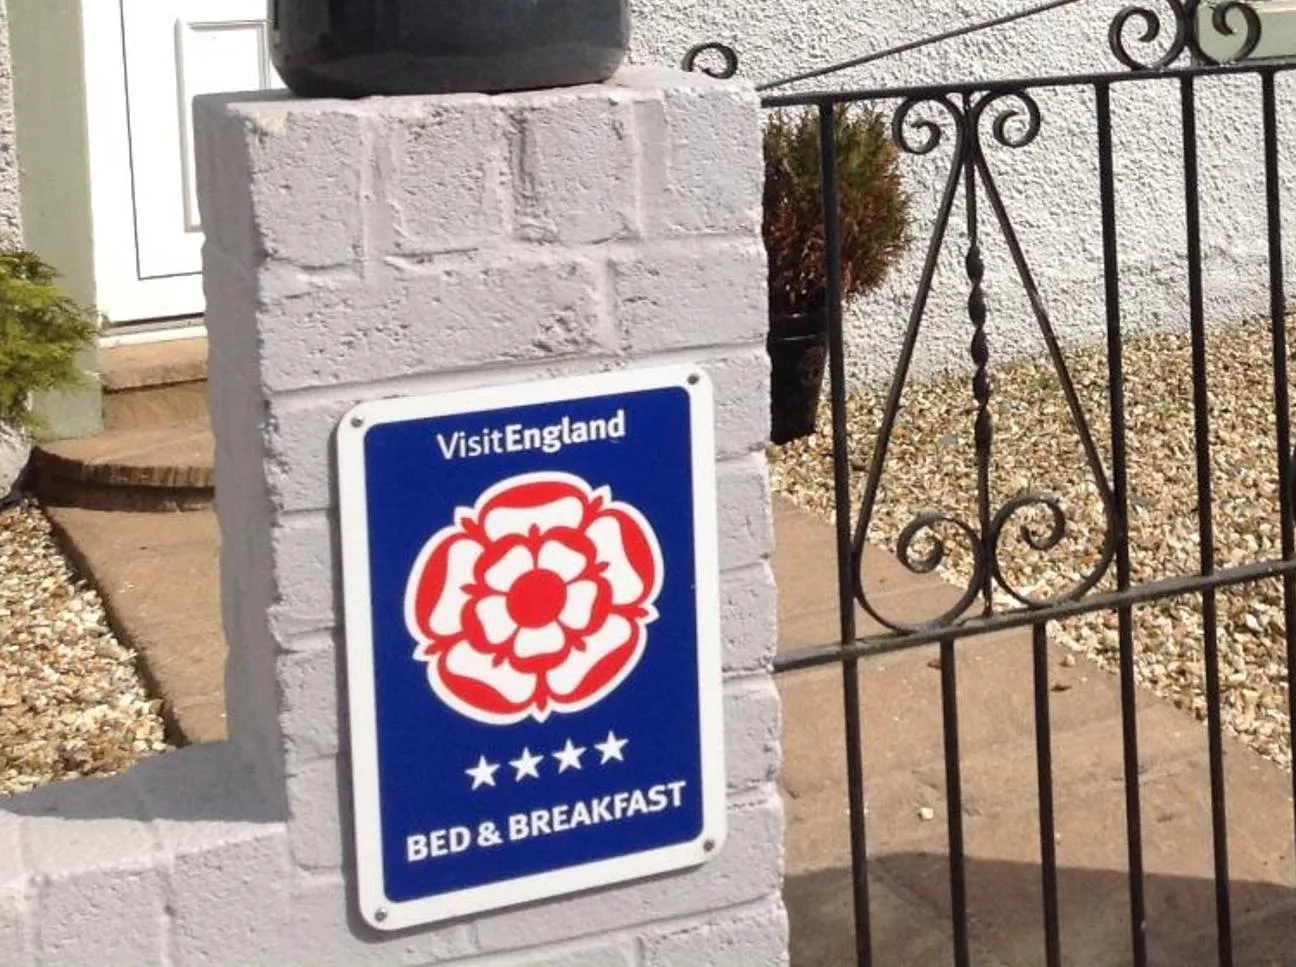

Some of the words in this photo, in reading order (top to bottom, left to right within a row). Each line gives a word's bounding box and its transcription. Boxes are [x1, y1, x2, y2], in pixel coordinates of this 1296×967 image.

[436, 409, 626, 460] VisitEngland
[406, 829, 471, 863] BED
[477, 821, 504, 847] &
[509, 781, 687, 842] BREAKFAST
